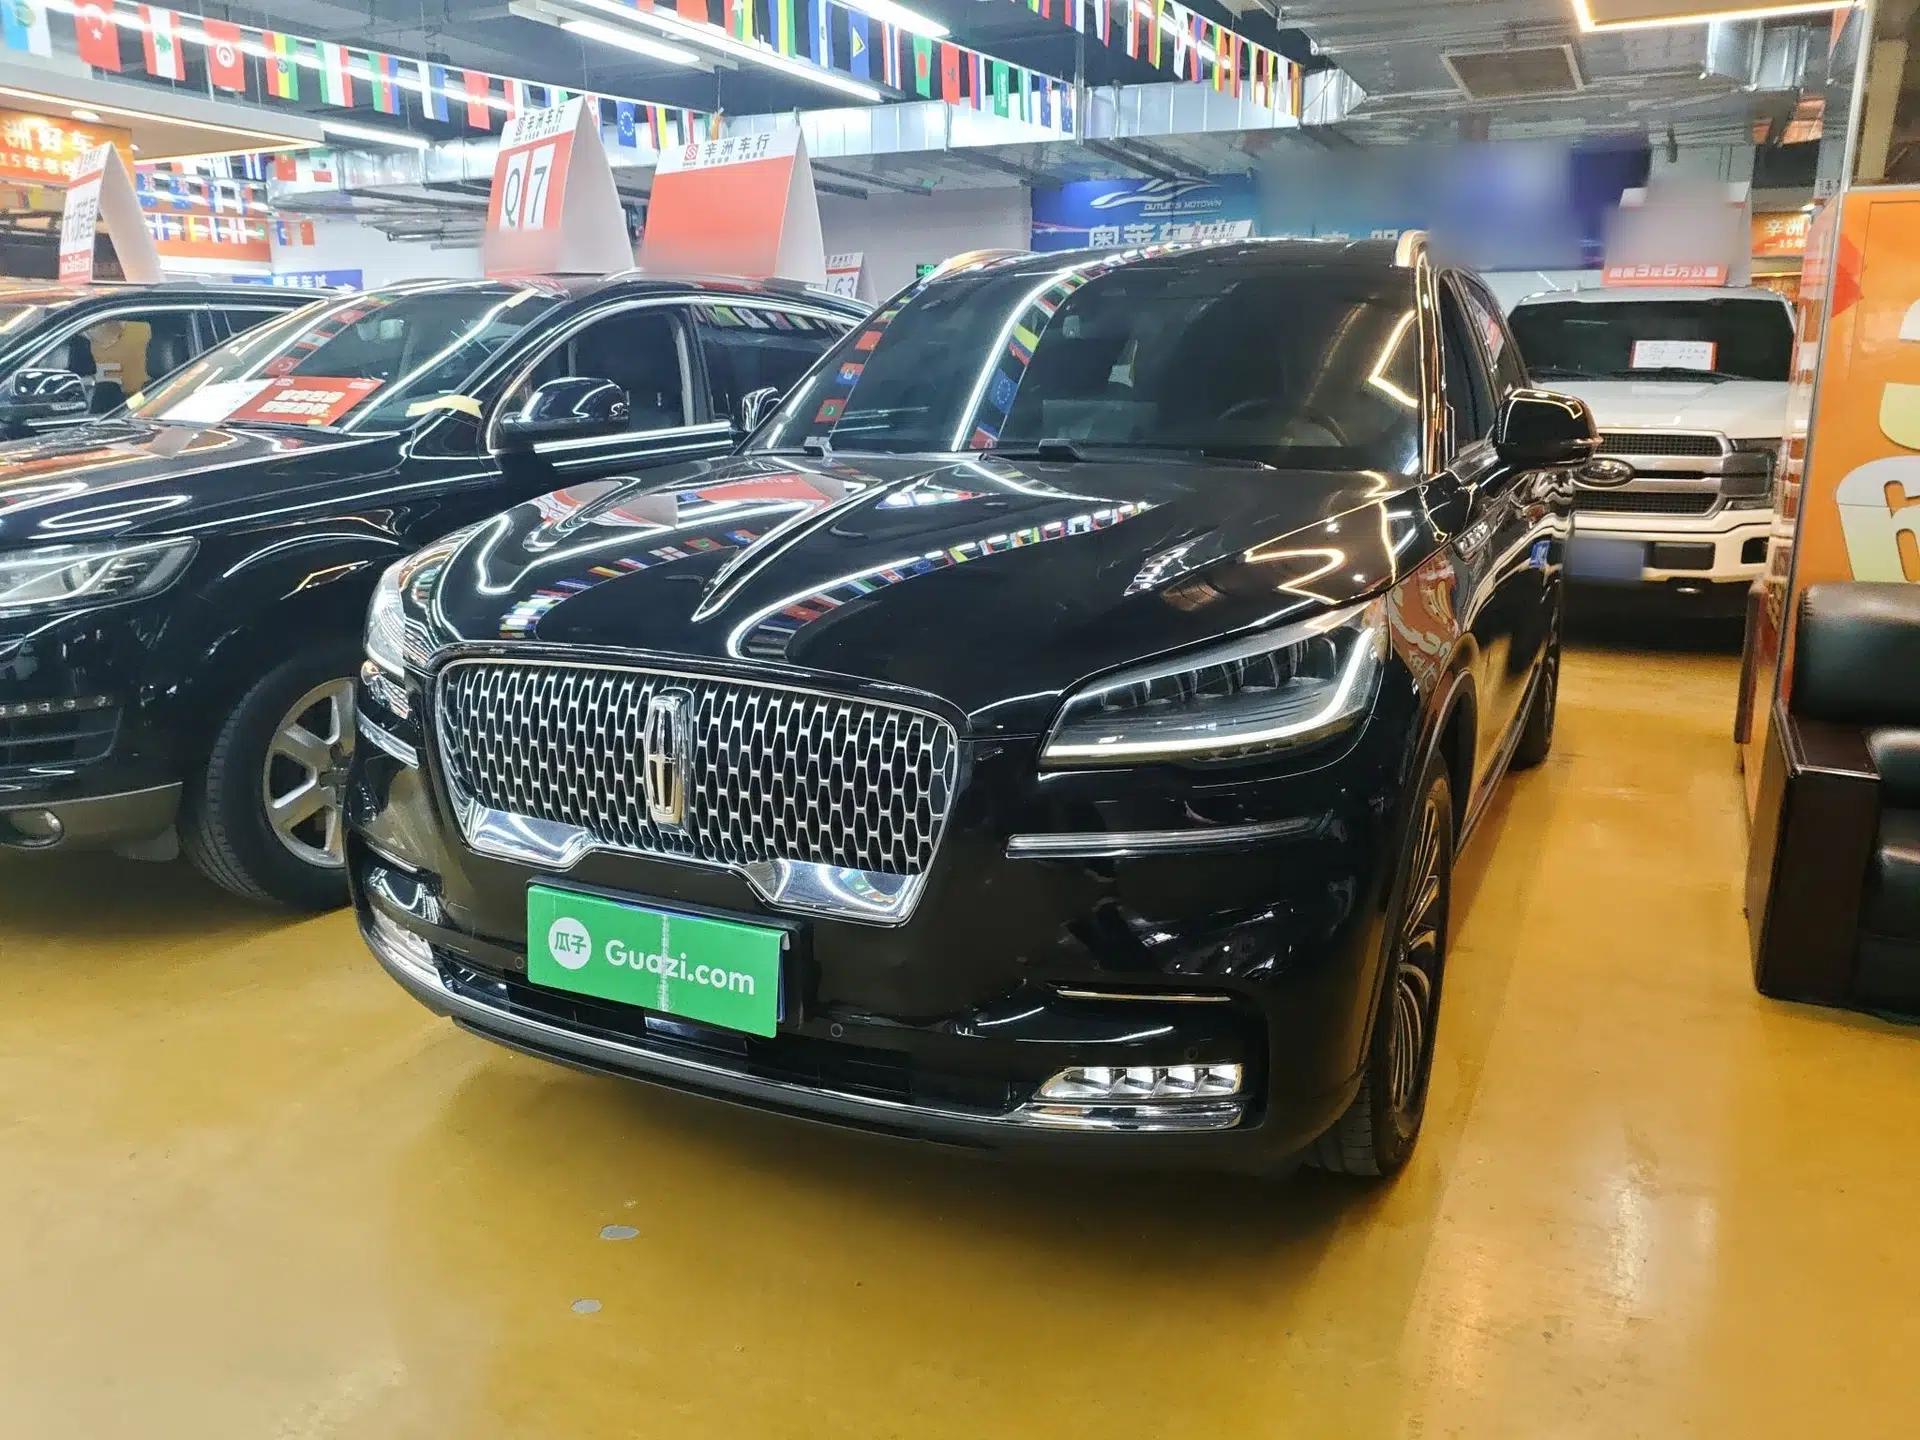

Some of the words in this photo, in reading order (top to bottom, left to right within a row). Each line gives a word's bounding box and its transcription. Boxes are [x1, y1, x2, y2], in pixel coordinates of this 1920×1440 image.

[704, 133, 770, 158] 辛洲车行
[505, 165, 547, 228] Q7
[1144, 202, 1182, 211] OUTLES
[1764, 218, 1811, 237] 辛洲
[554, 931, 587, 955] 瓜子
[605, 939, 755, 996] Guazi.com
